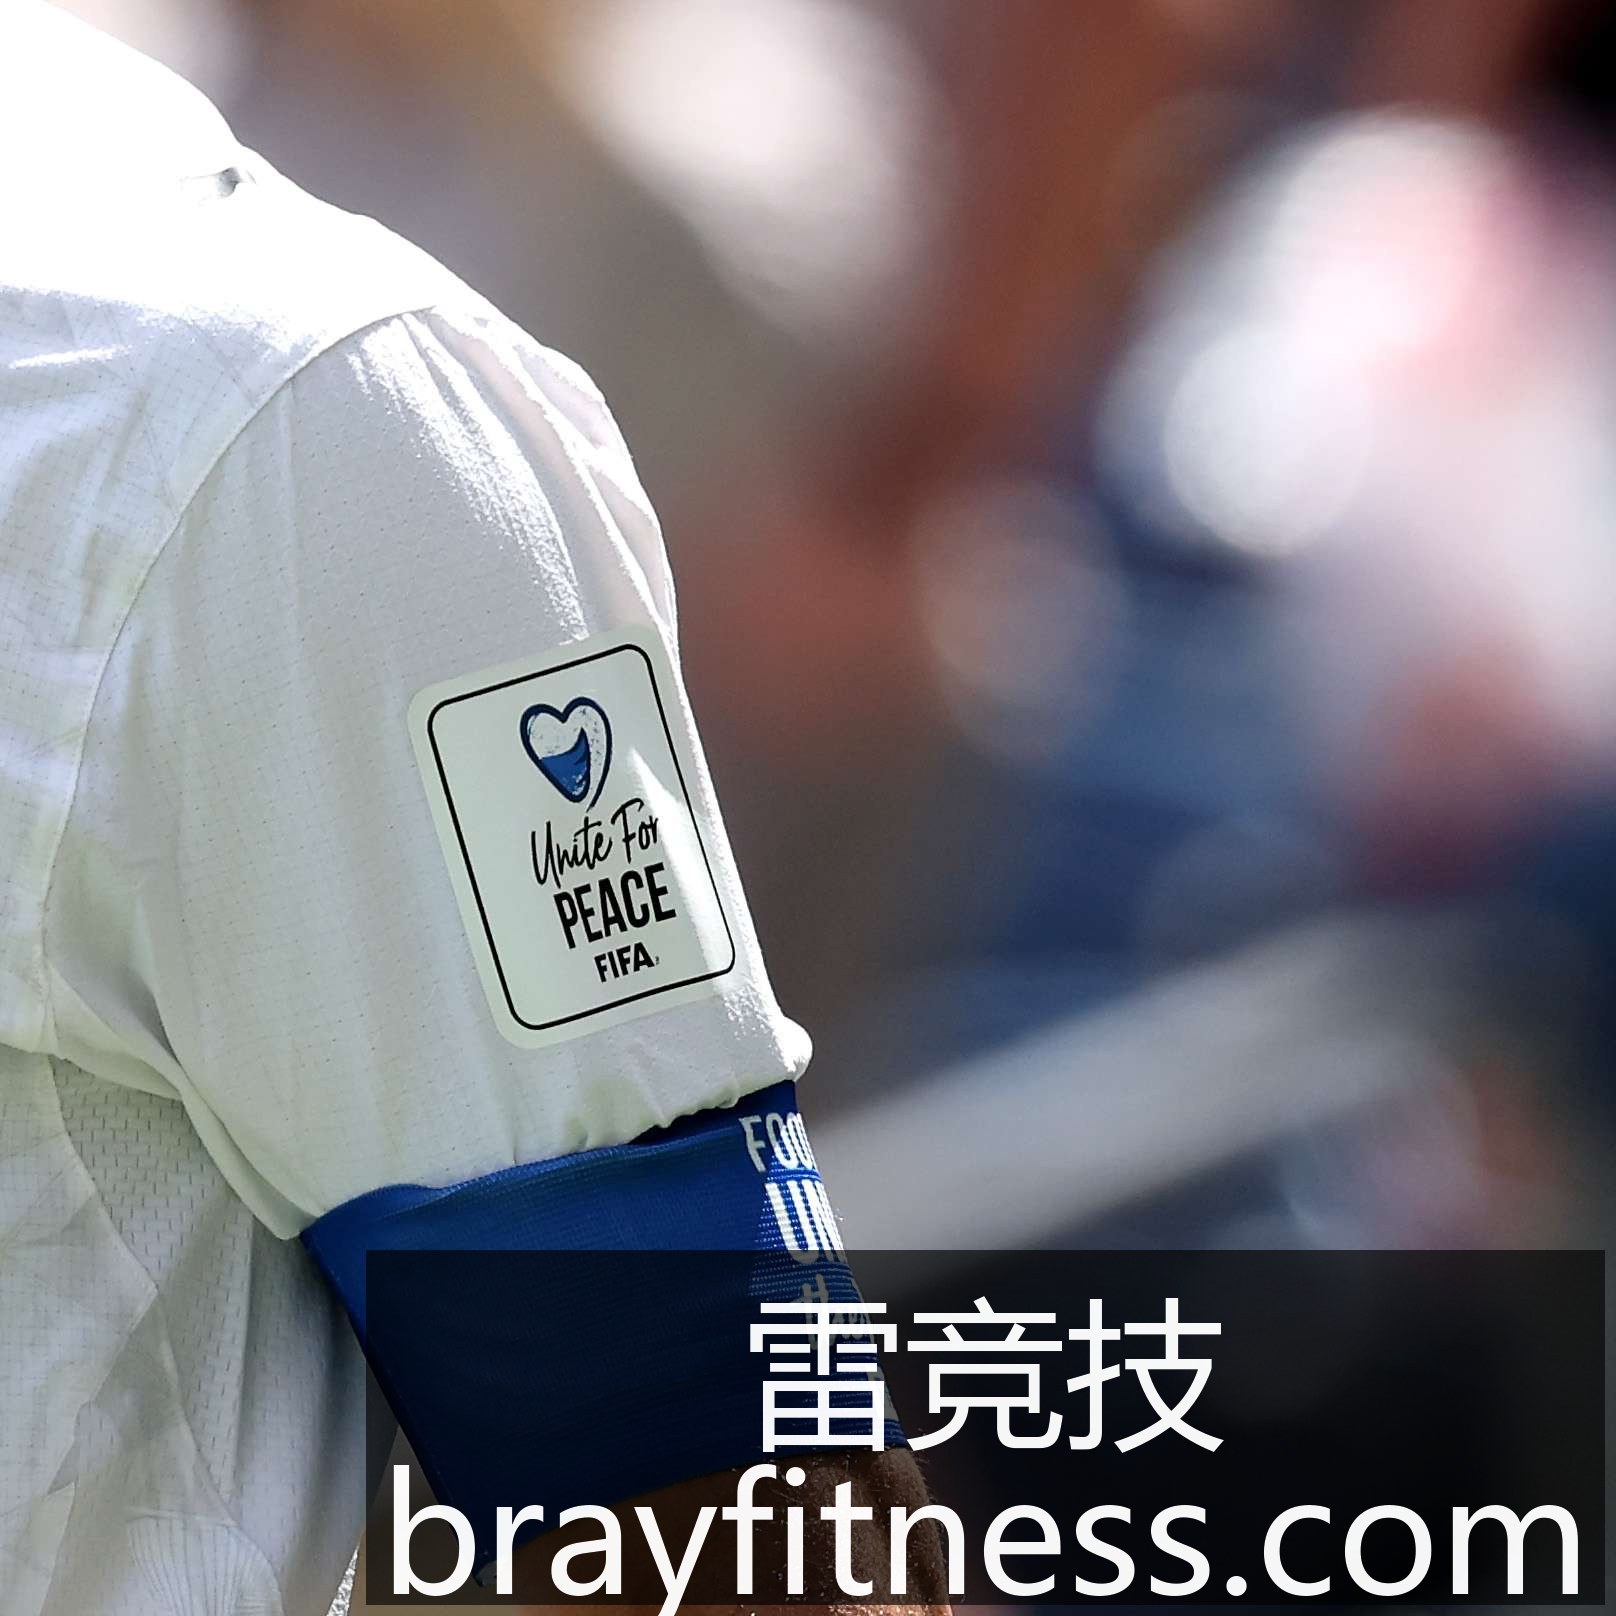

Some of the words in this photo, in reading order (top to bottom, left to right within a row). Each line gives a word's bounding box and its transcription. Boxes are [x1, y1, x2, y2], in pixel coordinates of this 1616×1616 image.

[531, 816, 613, 889] Unite
[610, 797, 659, 864] For
[553, 862, 677, 950] PEACE
[594, 941, 655, 983] FIFA
